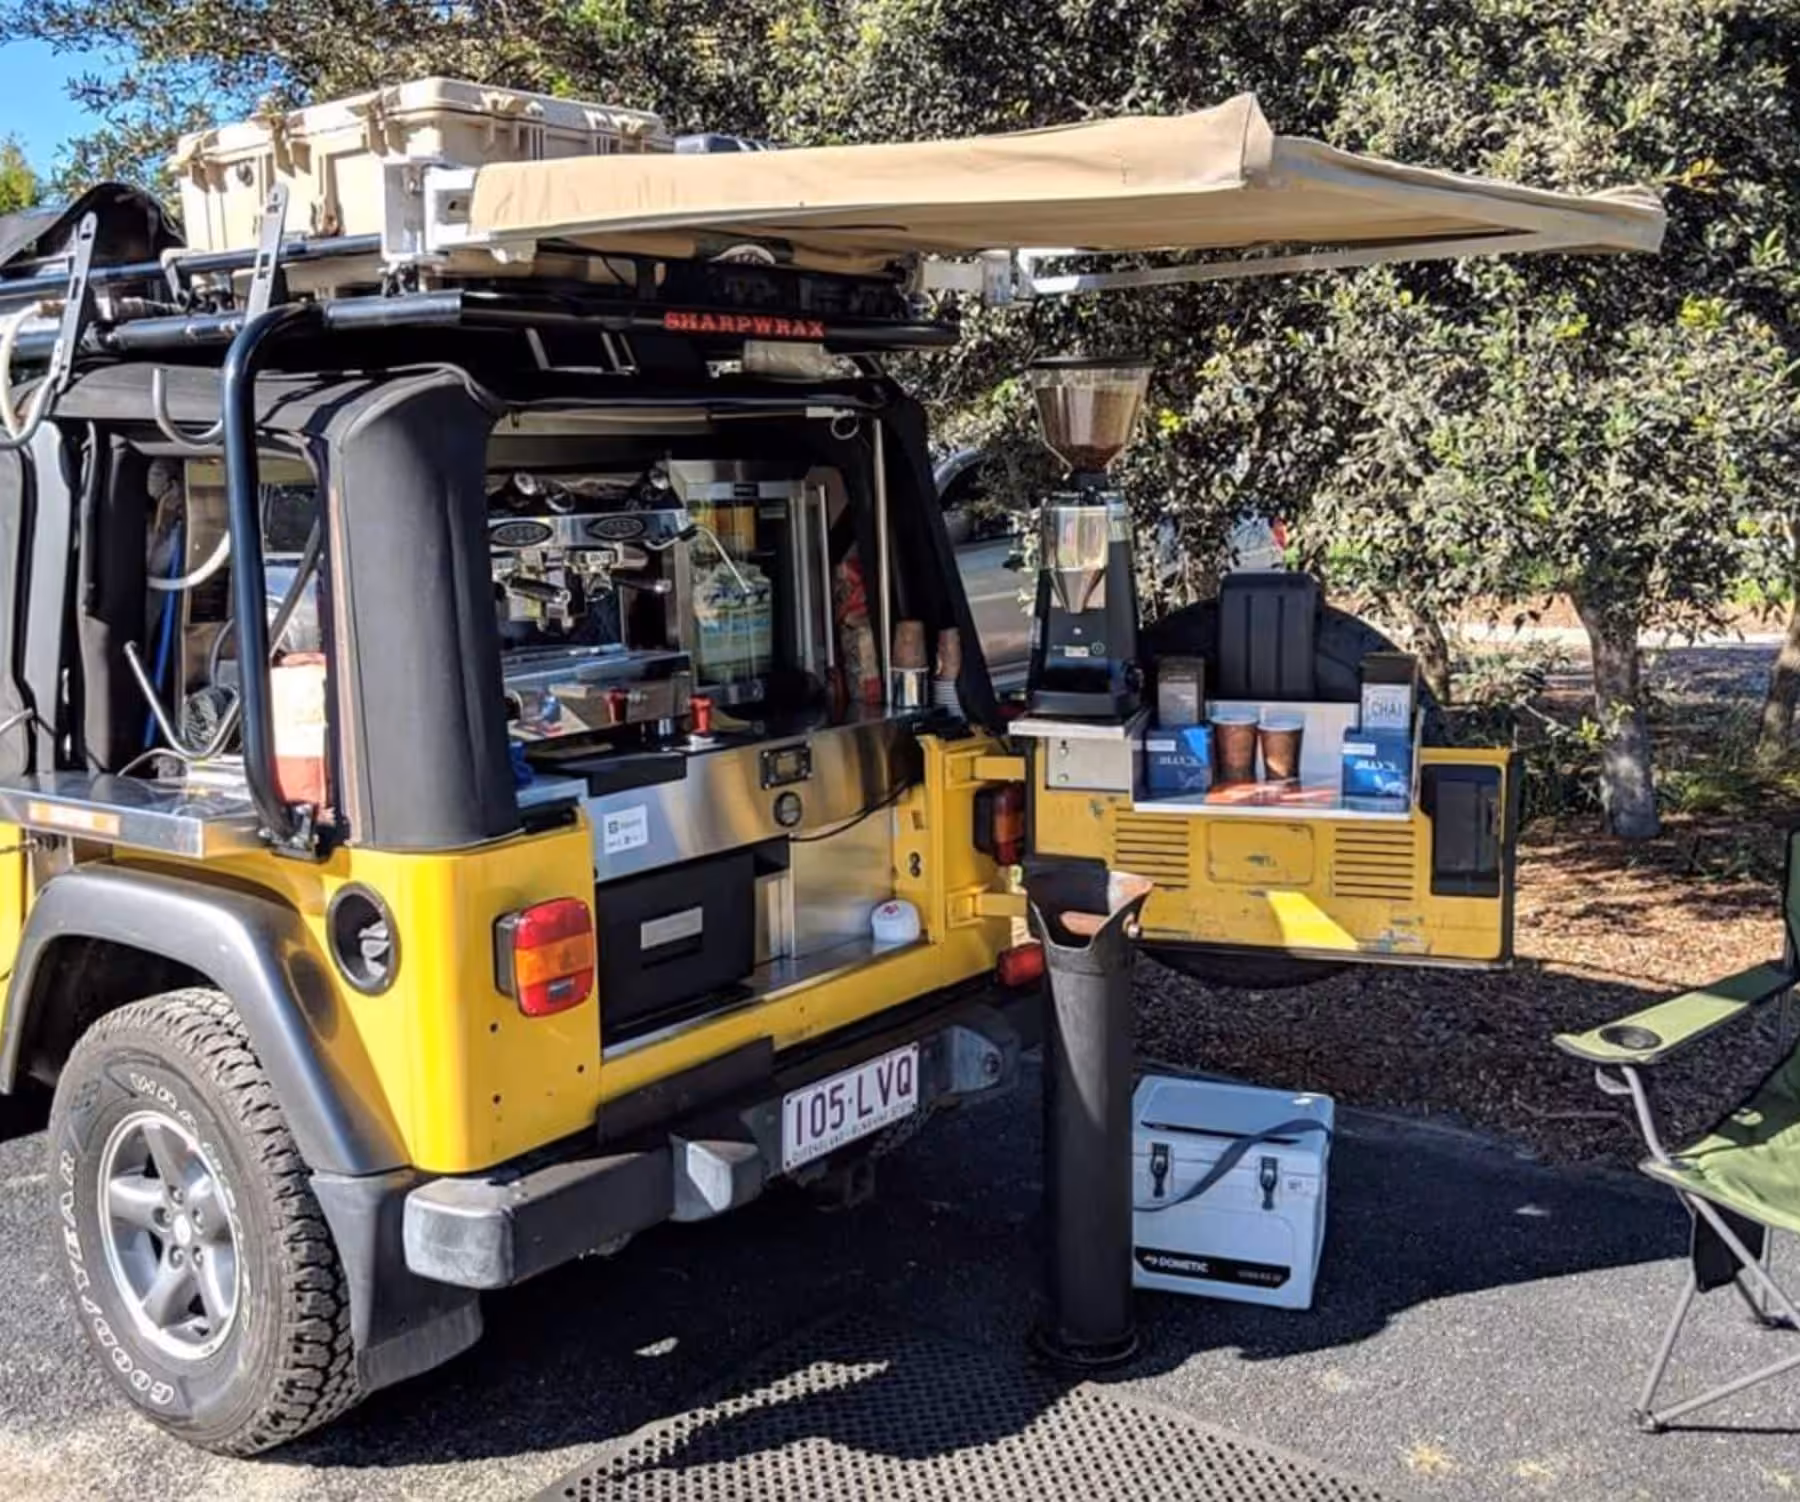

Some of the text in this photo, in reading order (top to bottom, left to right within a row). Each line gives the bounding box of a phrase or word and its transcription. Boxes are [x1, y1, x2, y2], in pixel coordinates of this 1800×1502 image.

[663, 311, 826, 338] SHARPWRAX
[60, 1150, 174, 1405] GOODYEAR
[1158, 1256, 1209, 1274] DOMETIC
